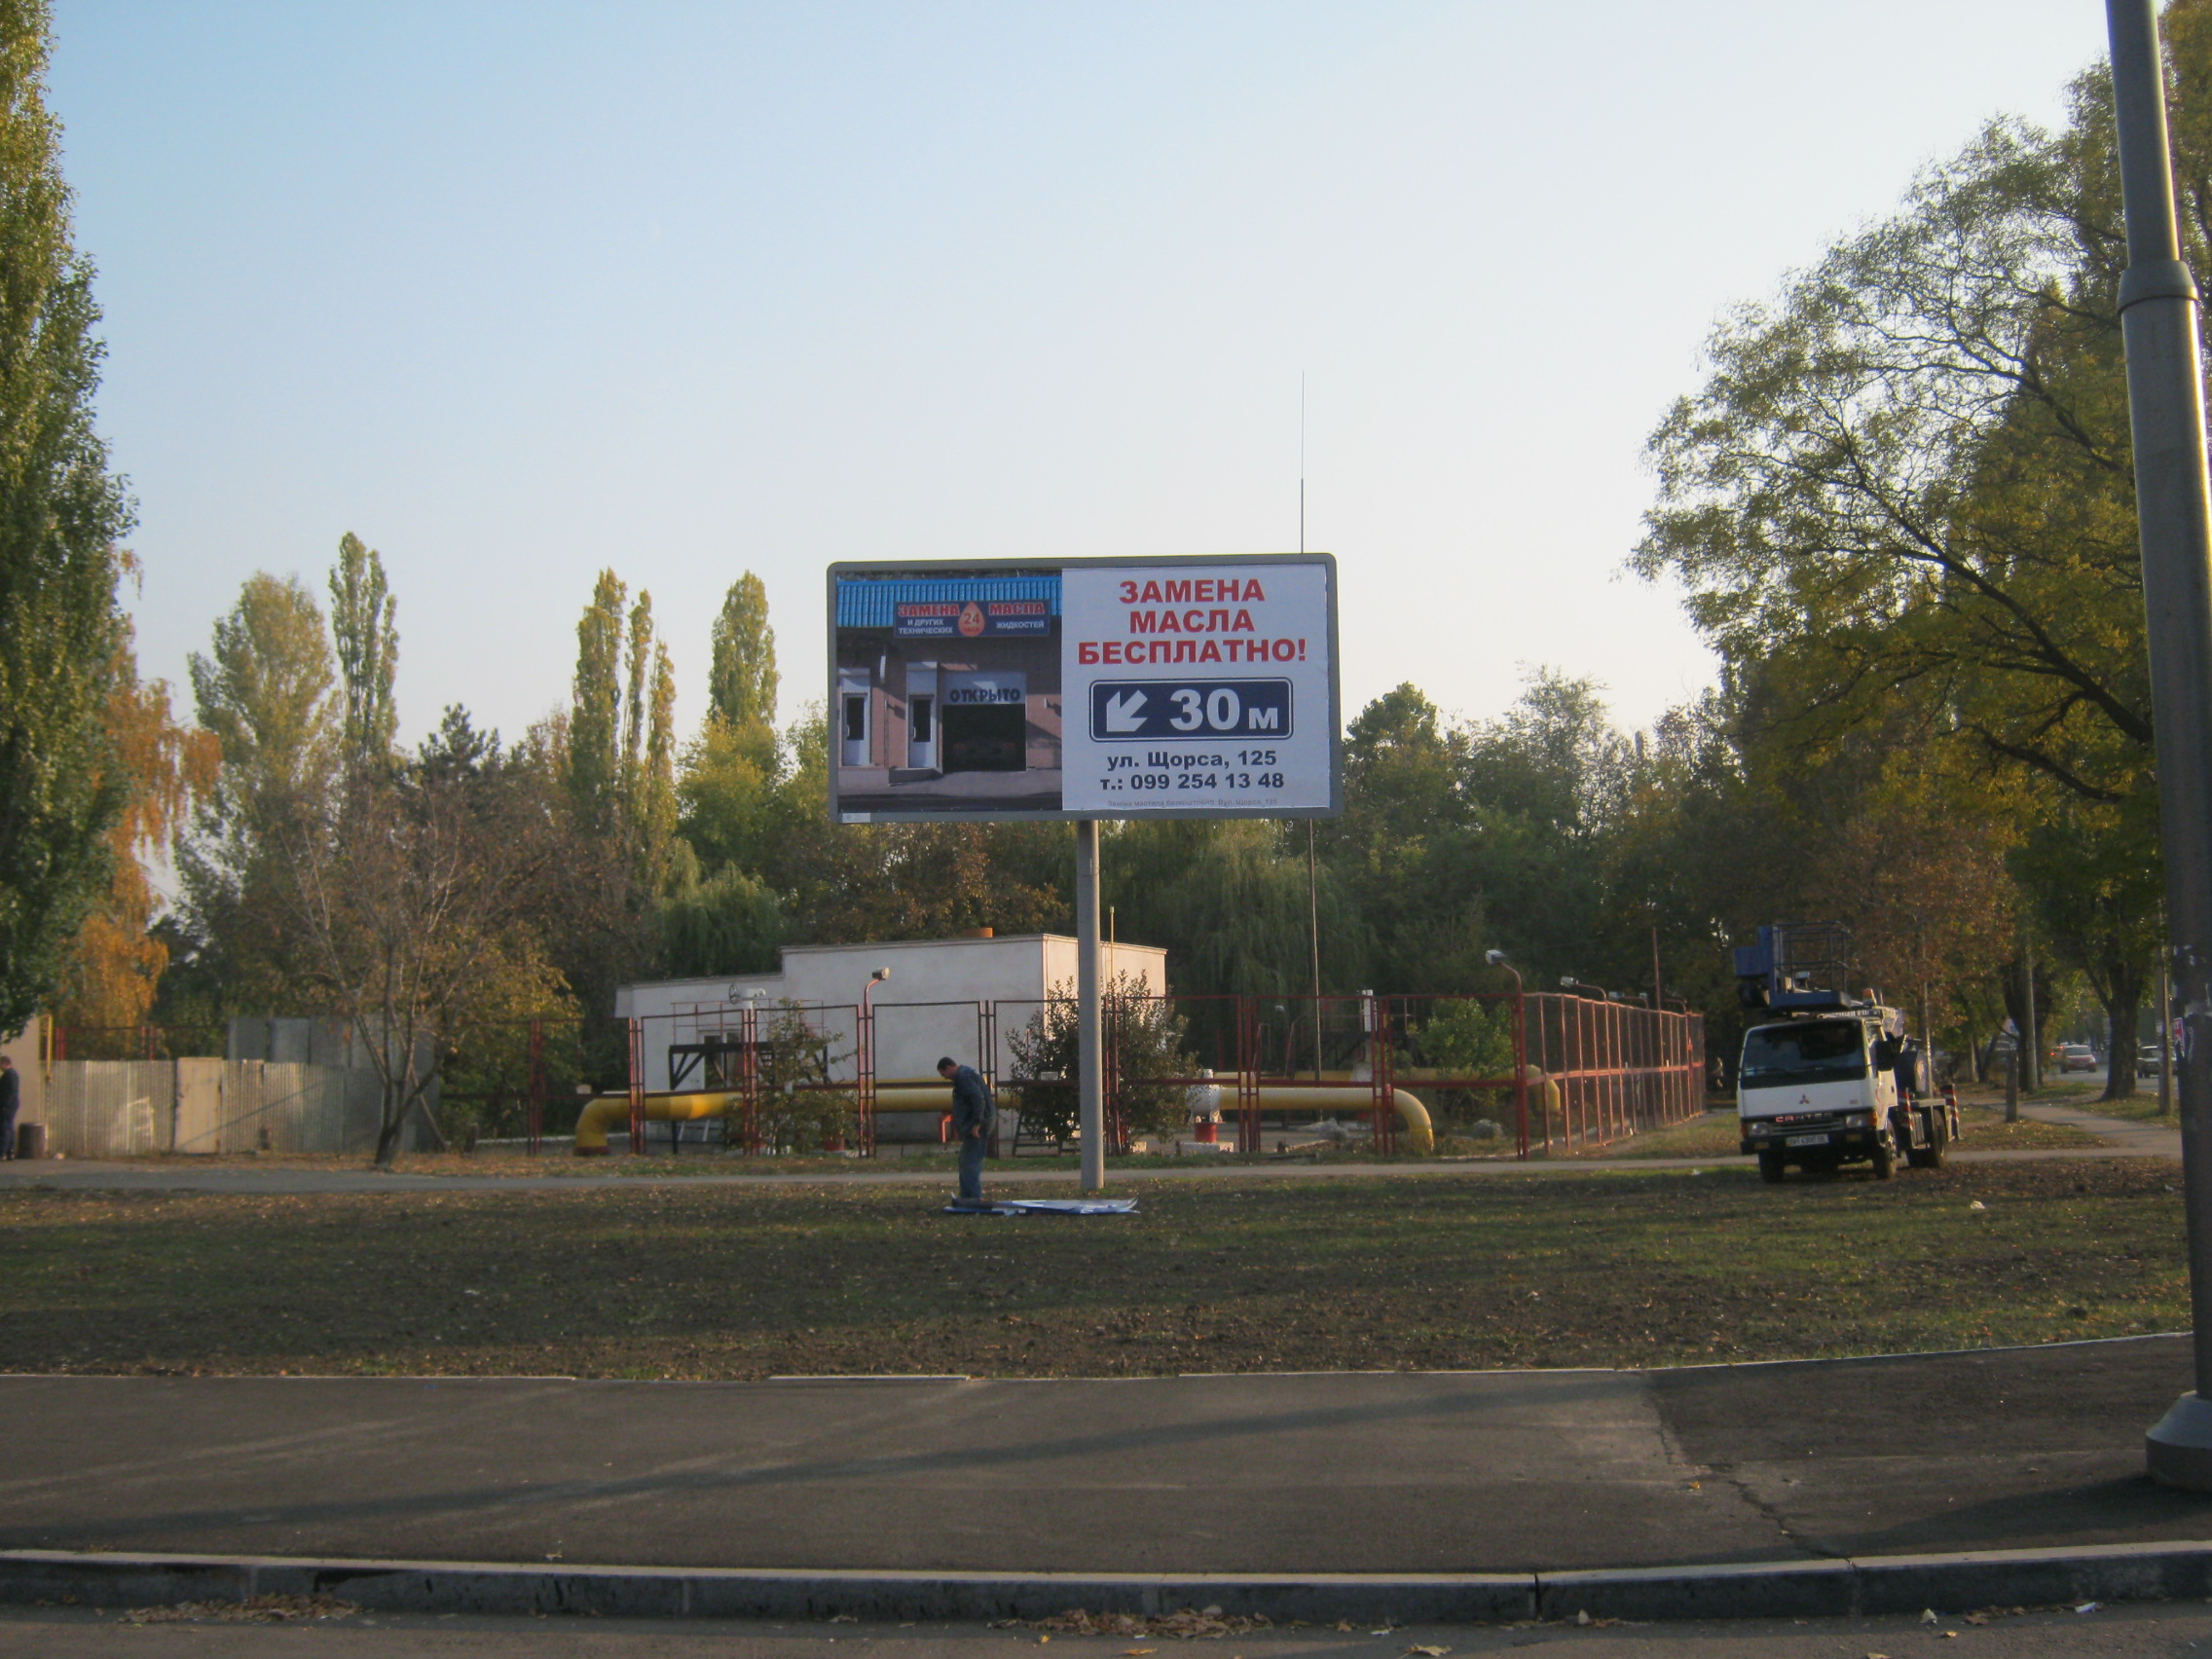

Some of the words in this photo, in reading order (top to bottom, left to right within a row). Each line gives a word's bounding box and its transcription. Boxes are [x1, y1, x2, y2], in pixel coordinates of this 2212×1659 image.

[1120, 578, 1265, 604] ЗАМЕНА
[898, 604, 960, 616] ЗАМЕНА
[989, 603, 1045, 615] МАСЛА
[964, 612, 980, 625] 24
[996, 620, 1045, 629] ЖИДКОСТЕЙ
[1129, 608, 1255, 634] МАСЛА
[1078, 639, 1307, 665] БЕСПЛАТНО!
[949, 688, 1021, 703] ОТКРЫТО
[1169, 688, 1240, 730] 30
[1107, 756, 1140, 771] ул.
[1147, 752, 1230, 769] Щорса,
[1237, 750, 1277, 766] 125
[1100, 778, 1124, 790] т.:
[1130, 774, 1170, 790] 099
[1177, 773, 1217, 789] 254
[1225, 772, 1251, 789] 13
[1258, 772, 1284, 788] 48
